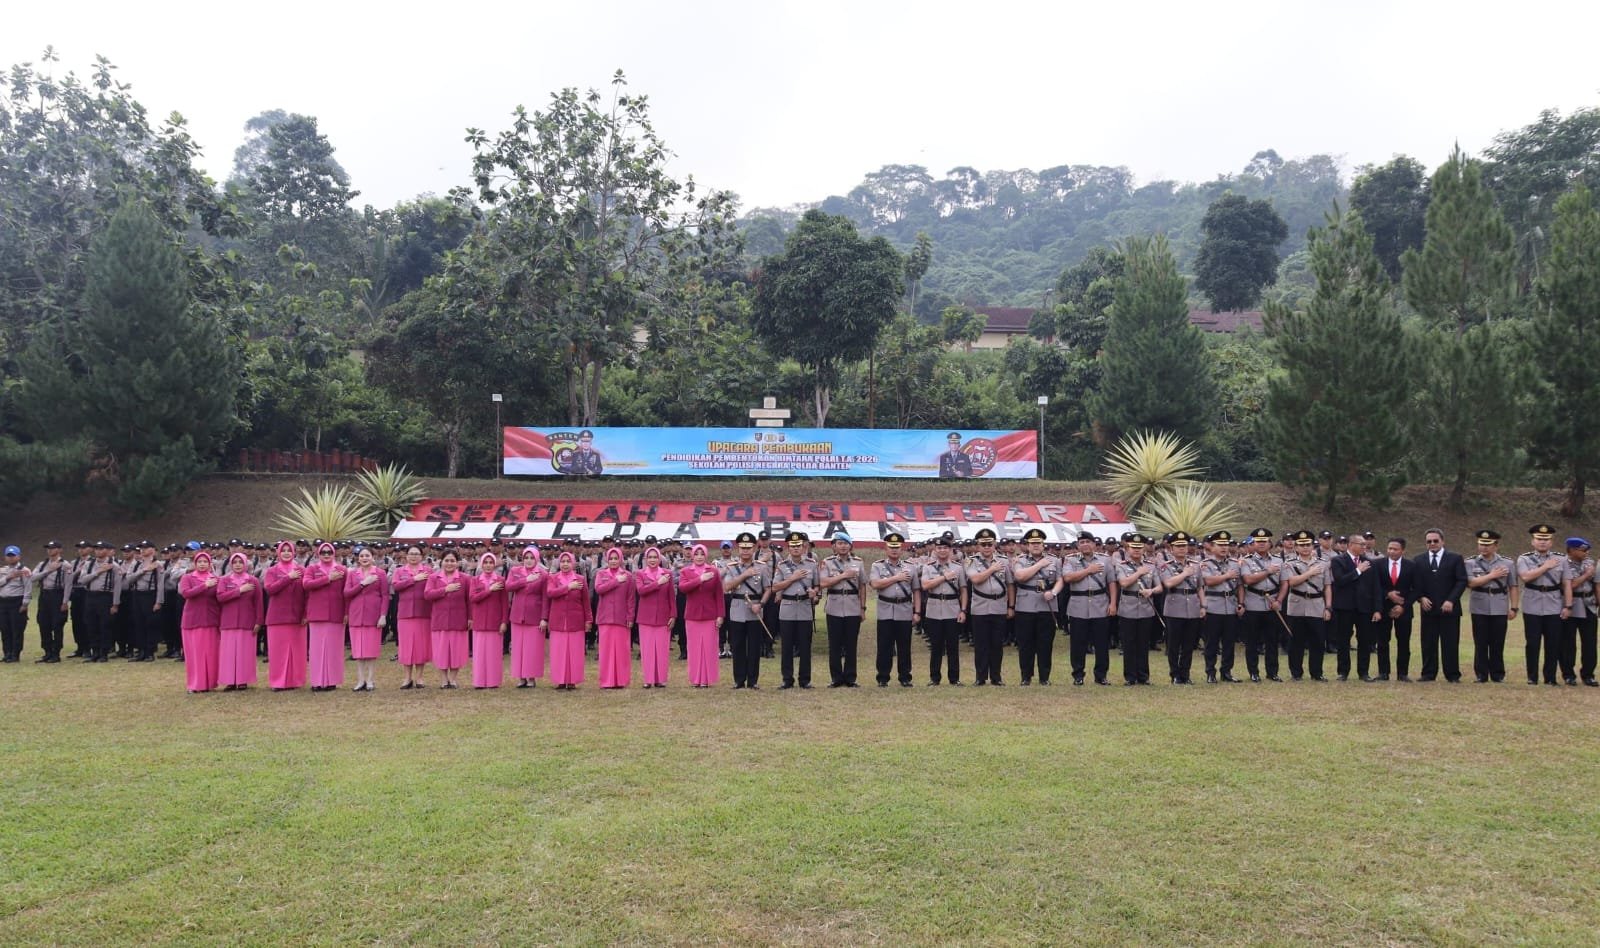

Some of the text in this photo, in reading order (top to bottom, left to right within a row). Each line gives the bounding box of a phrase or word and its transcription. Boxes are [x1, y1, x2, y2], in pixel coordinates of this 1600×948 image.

[548, 432, 579, 441] BANTEN
[707, 441, 832, 454] UPACARA PEMBUKAAN
[661, 453, 711, 461] PENDIDIKAN
[714, 454, 774, 462] PEMBENTUKAN
[776, 455, 813, 463] BINTARA
[815, 455, 840, 463] POLRI
[855, 455, 878, 463] 2026
[688, 461, 725, 469] SEKOLAH
[727, 461, 753, 469] POLISI
[790, 462, 818, 470] POLDA
[819, 462, 851, 470] BANTEN
[425, 504, 1108, 523] SEKOLAH POLISI NEGARA
[431, 521, 1085, 542] POLDA BANTEN
